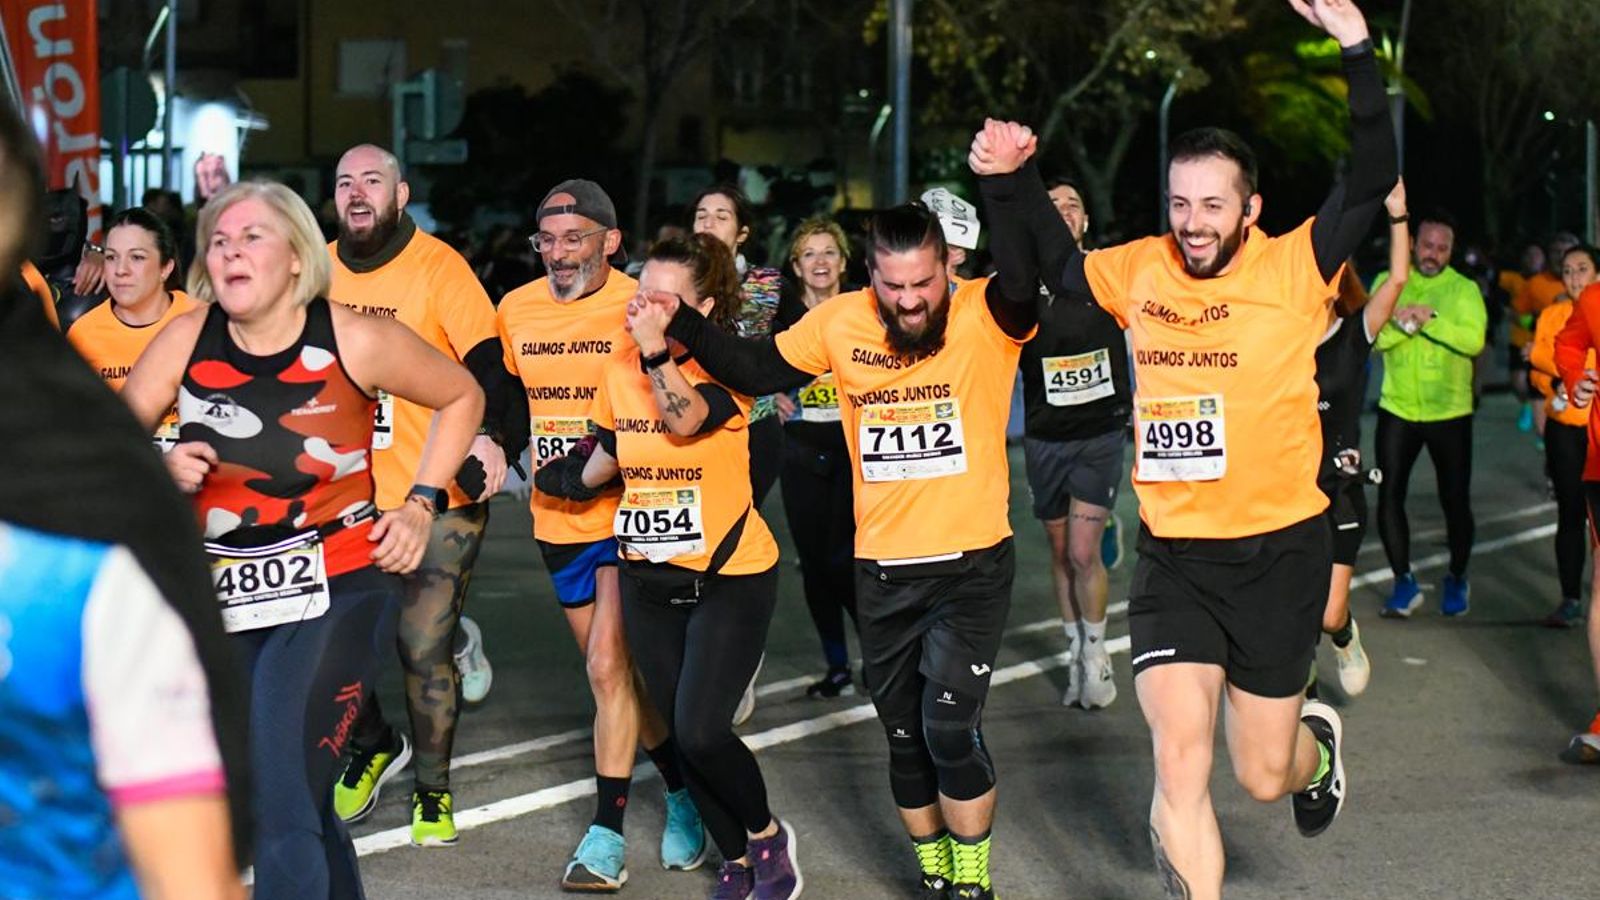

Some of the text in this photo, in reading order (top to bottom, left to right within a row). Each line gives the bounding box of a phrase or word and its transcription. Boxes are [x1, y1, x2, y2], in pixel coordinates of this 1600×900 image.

[521, 340, 612, 356] SALIMOS JUNTOS
[852, 348, 901, 369] SALIMOS
[1188, 351, 1238, 367] JUNTOS
[1051, 363, 1103, 386] 4591
[903, 383, 950, 402] JUNTOS
[880, 408, 896, 421] 42
[543, 420, 557, 432] 42
[1146, 421, 1215, 449] 4998
[868, 422, 953, 452] 7112
[655, 466, 702, 481] JUNTOS
[619, 508, 693, 534] 7054
[216, 556, 314, 596] 4802
